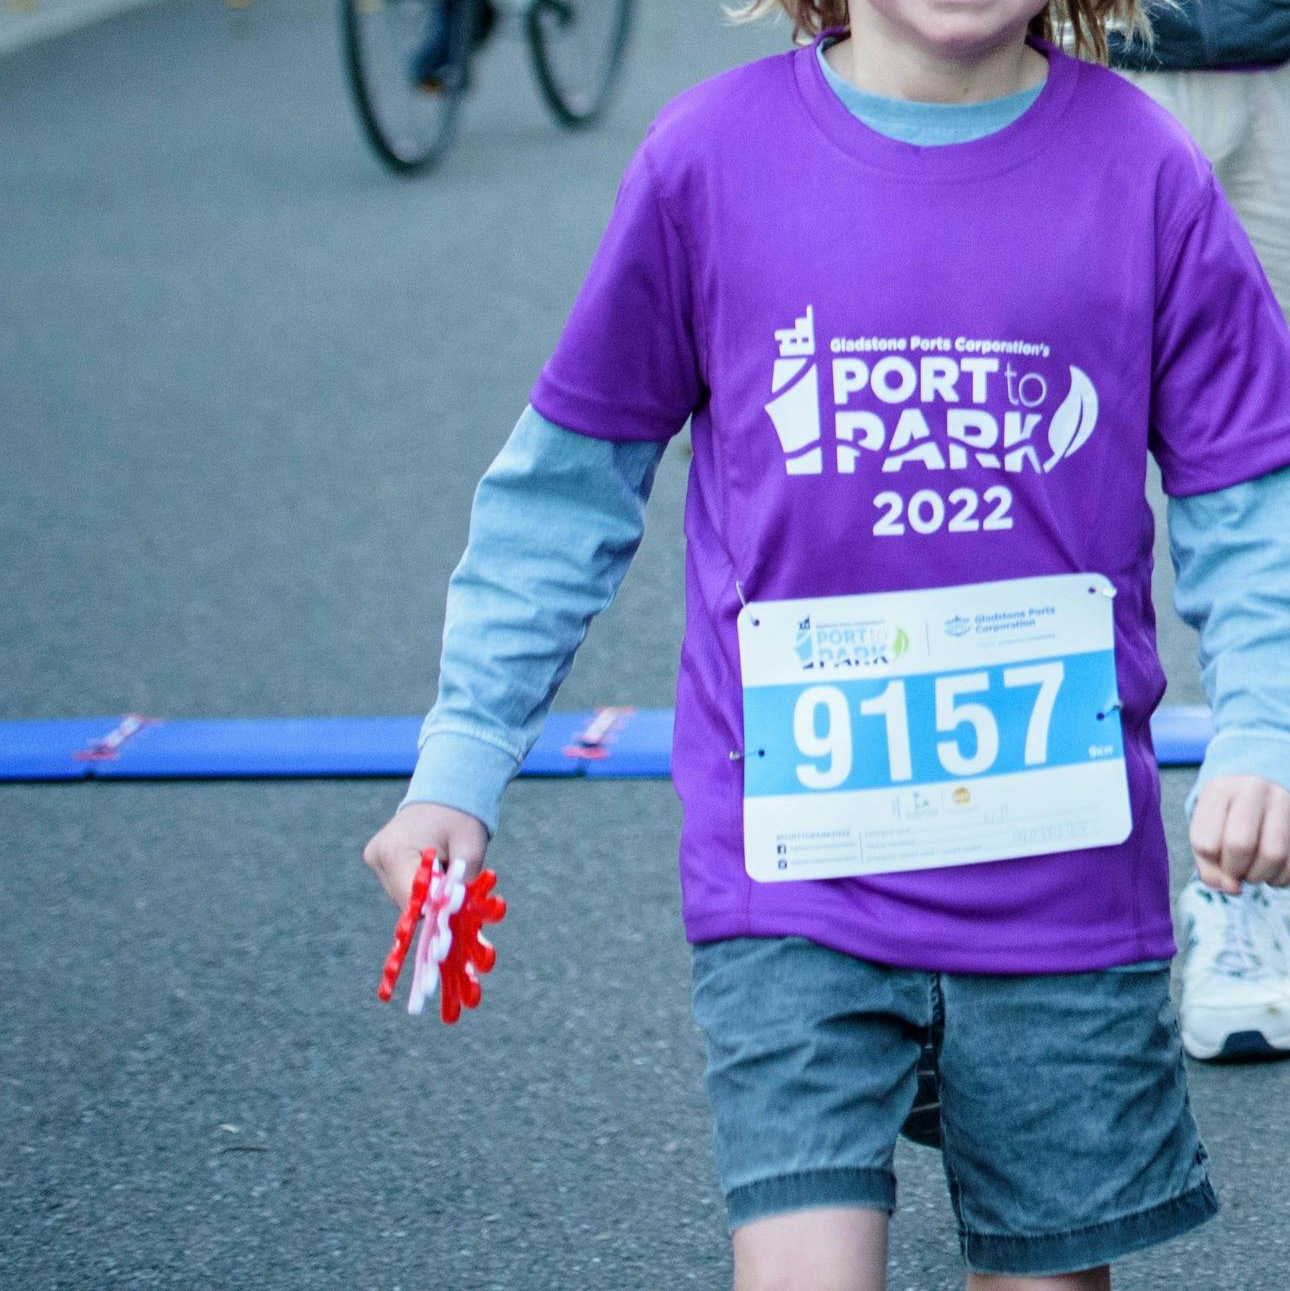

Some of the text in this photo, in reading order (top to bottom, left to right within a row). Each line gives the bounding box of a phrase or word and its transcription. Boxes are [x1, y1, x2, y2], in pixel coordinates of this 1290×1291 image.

[830, 335, 1050, 358] Gladstone Ports Corporation's
[832, 356, 1047, 407] PORT to
[834, 408, 1043, 474] PARK
[872, 485, 1014, 536] 2022
[974, 606, 1056, 625] Gladstone Ports
[974, 617, 1036, 635] Corporation
[816, 627, 866, 645] PORT
[818, 644, 889, 668] PARK
[793, 661, 1065, 790] 9157
